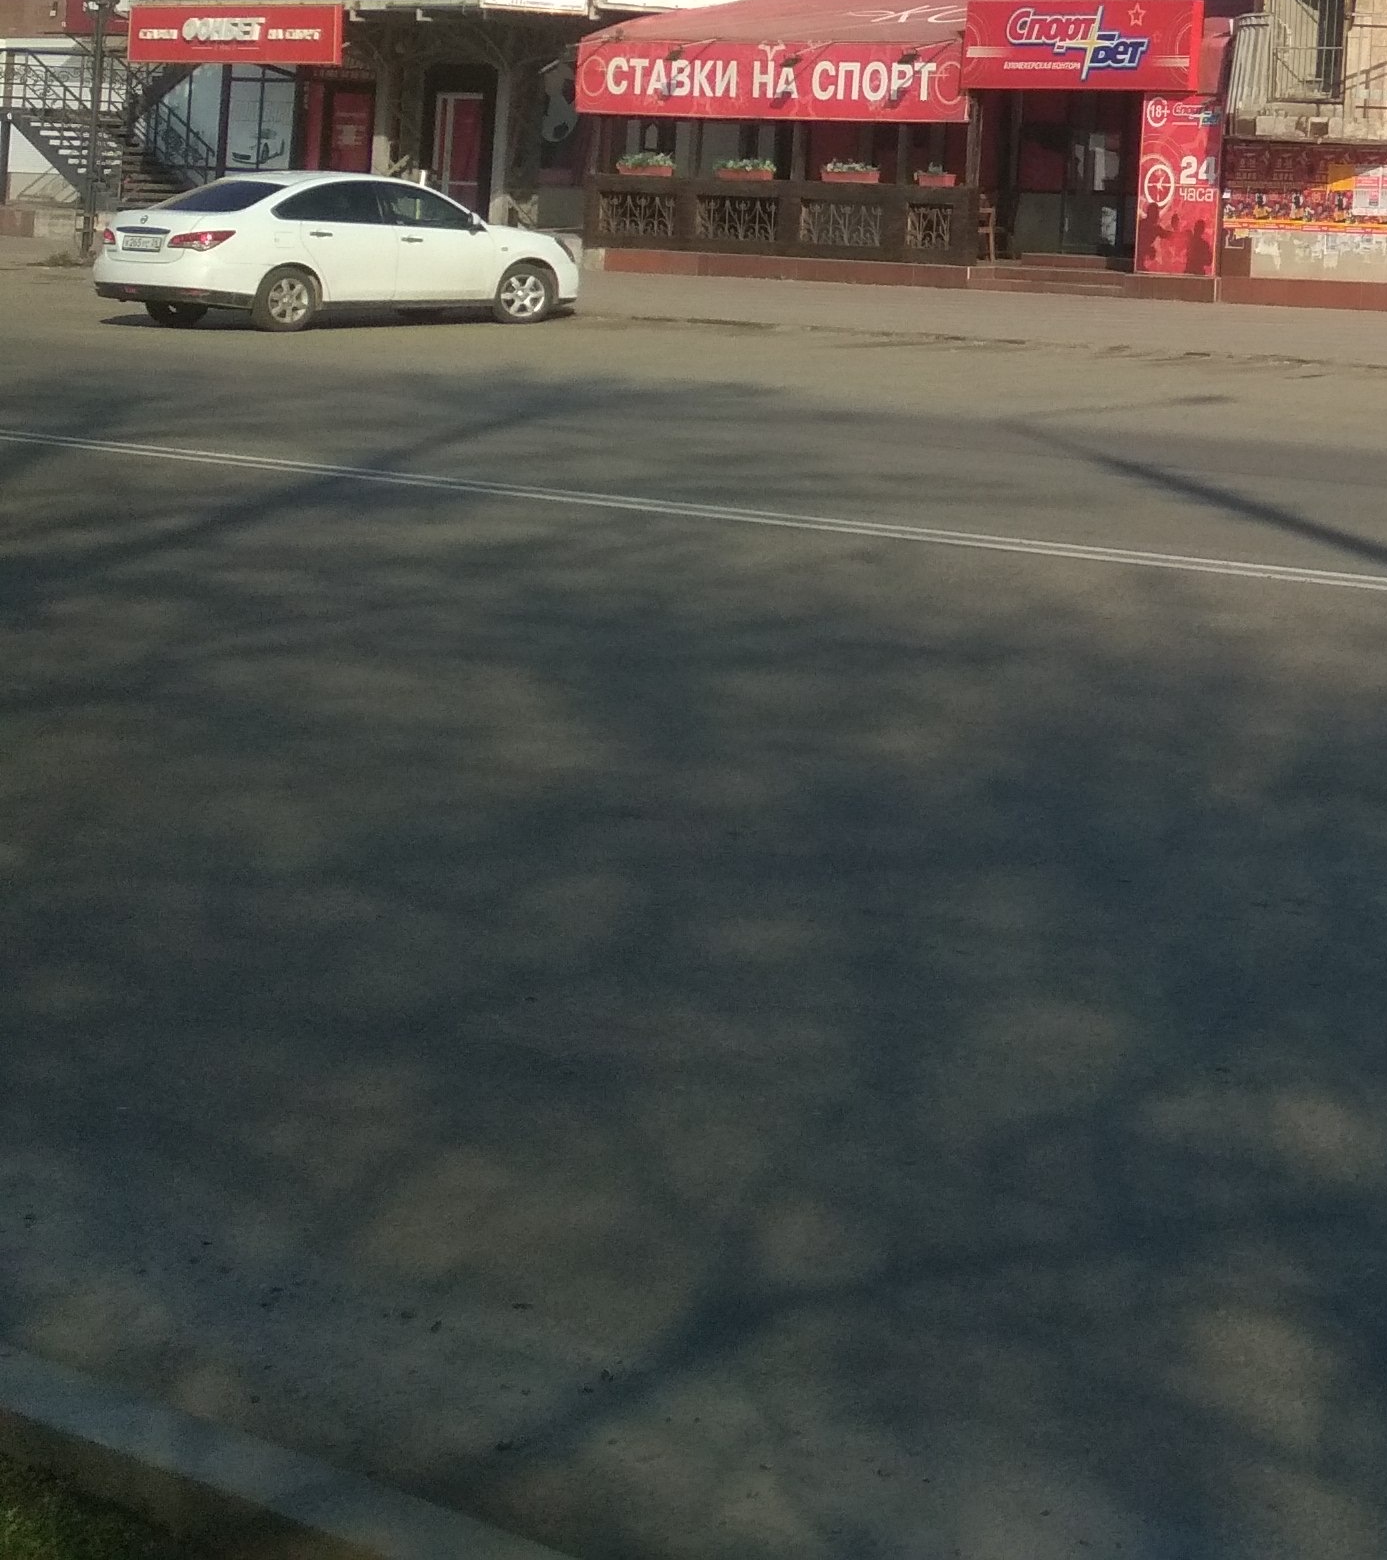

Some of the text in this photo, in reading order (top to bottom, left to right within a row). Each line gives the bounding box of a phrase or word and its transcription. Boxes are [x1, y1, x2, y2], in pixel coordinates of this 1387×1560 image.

[606, 57, 936, 101] СТАВКИ НА СПОРТ
[1150, 104, 1170, 118] 18+
[1180, 156, 1216, 185] 24
[1180, 188, 1214, 201] часа
